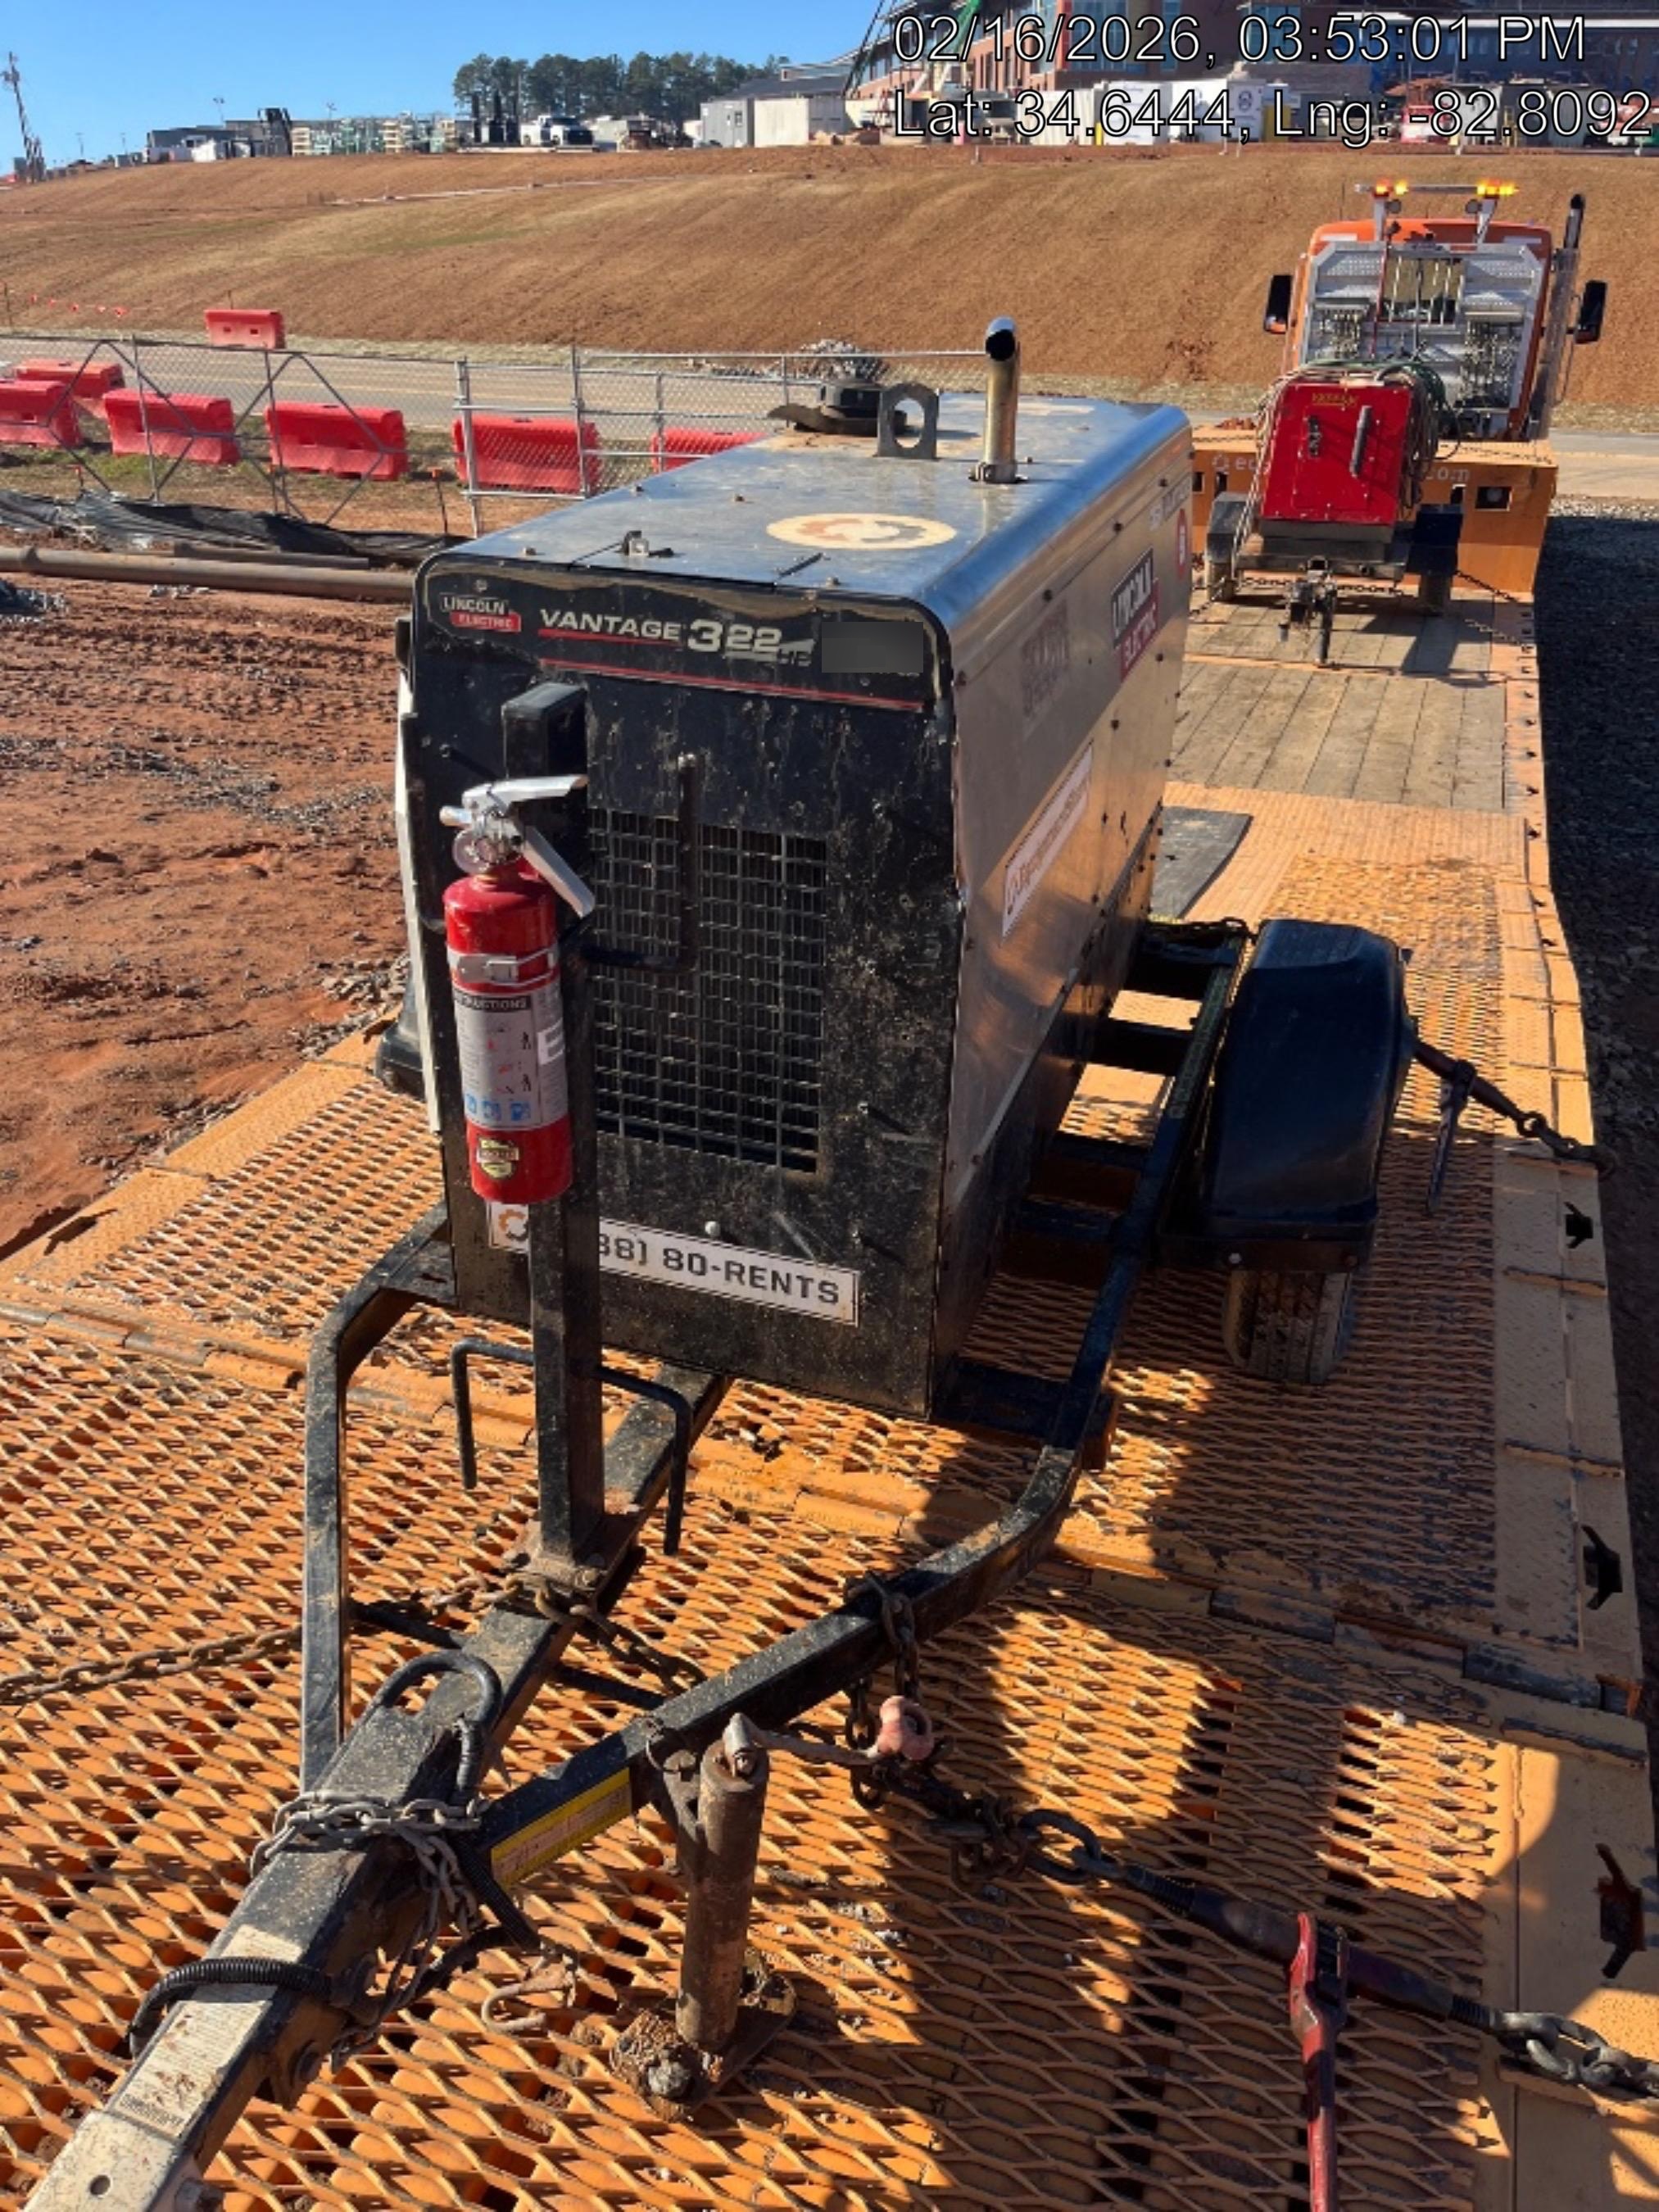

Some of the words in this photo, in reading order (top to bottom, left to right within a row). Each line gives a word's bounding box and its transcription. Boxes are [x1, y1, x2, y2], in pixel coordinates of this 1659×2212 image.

[443, 596, 505, 615] LINCOLN
[539, 608, 682, 641] VANTAGE
[687, 619, 782, 654] 322
[662, 1247, 840, 1304] 80-RENTS
